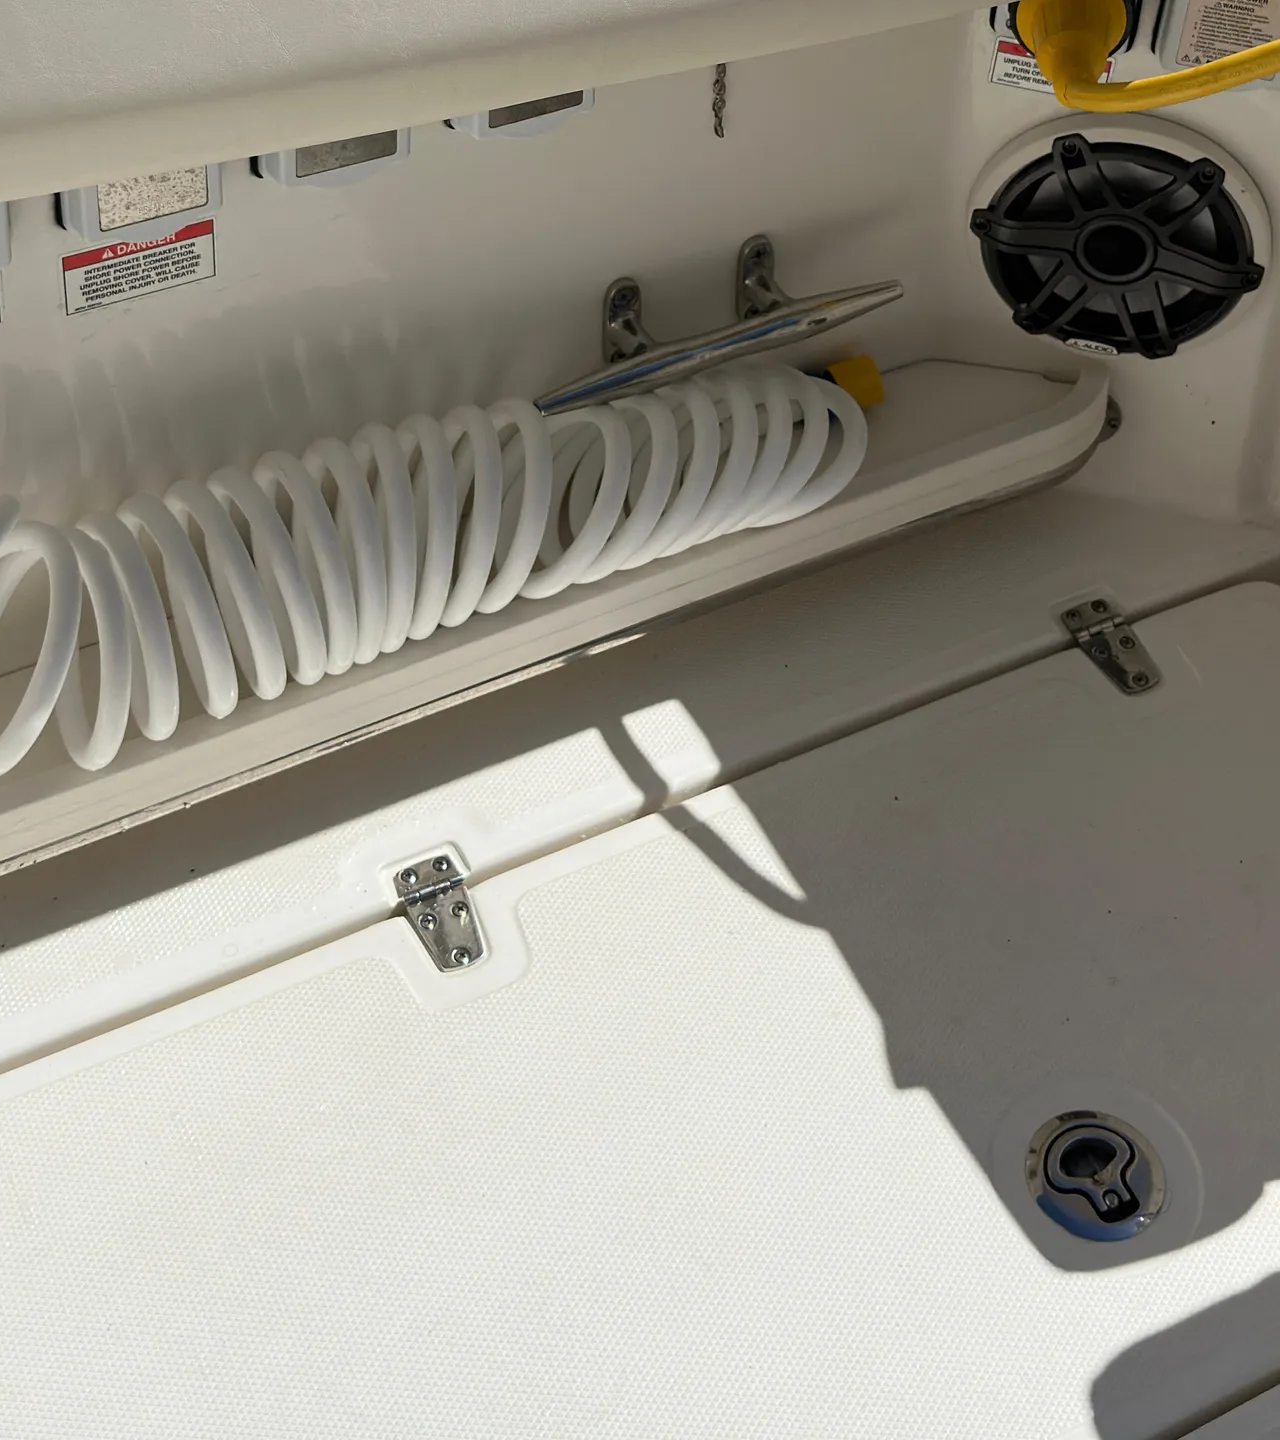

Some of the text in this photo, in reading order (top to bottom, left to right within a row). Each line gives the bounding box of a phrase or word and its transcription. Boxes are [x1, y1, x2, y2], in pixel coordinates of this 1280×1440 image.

[1223, 3, 1255, 13] WARNING
[1003, 57, 1032, 68] UNPLUG
[1003, 72, 1031, 83] BEFORE
[1012, 66, 1030, 75] TURN
[80, 254, 201, 291] UNPLUG SHORE POWER BEFORE
[84, 242, 196, 275] INTERMEDIATE BREAKER FOR
[84, 250, 196, 282] SHORE POWER CONNECTION.
[82, 261, 200, 296] REMOVING COVER. WILL CAUSE
[85, 269, 198, 303] PERSONAL INJURY OR DEATH.
